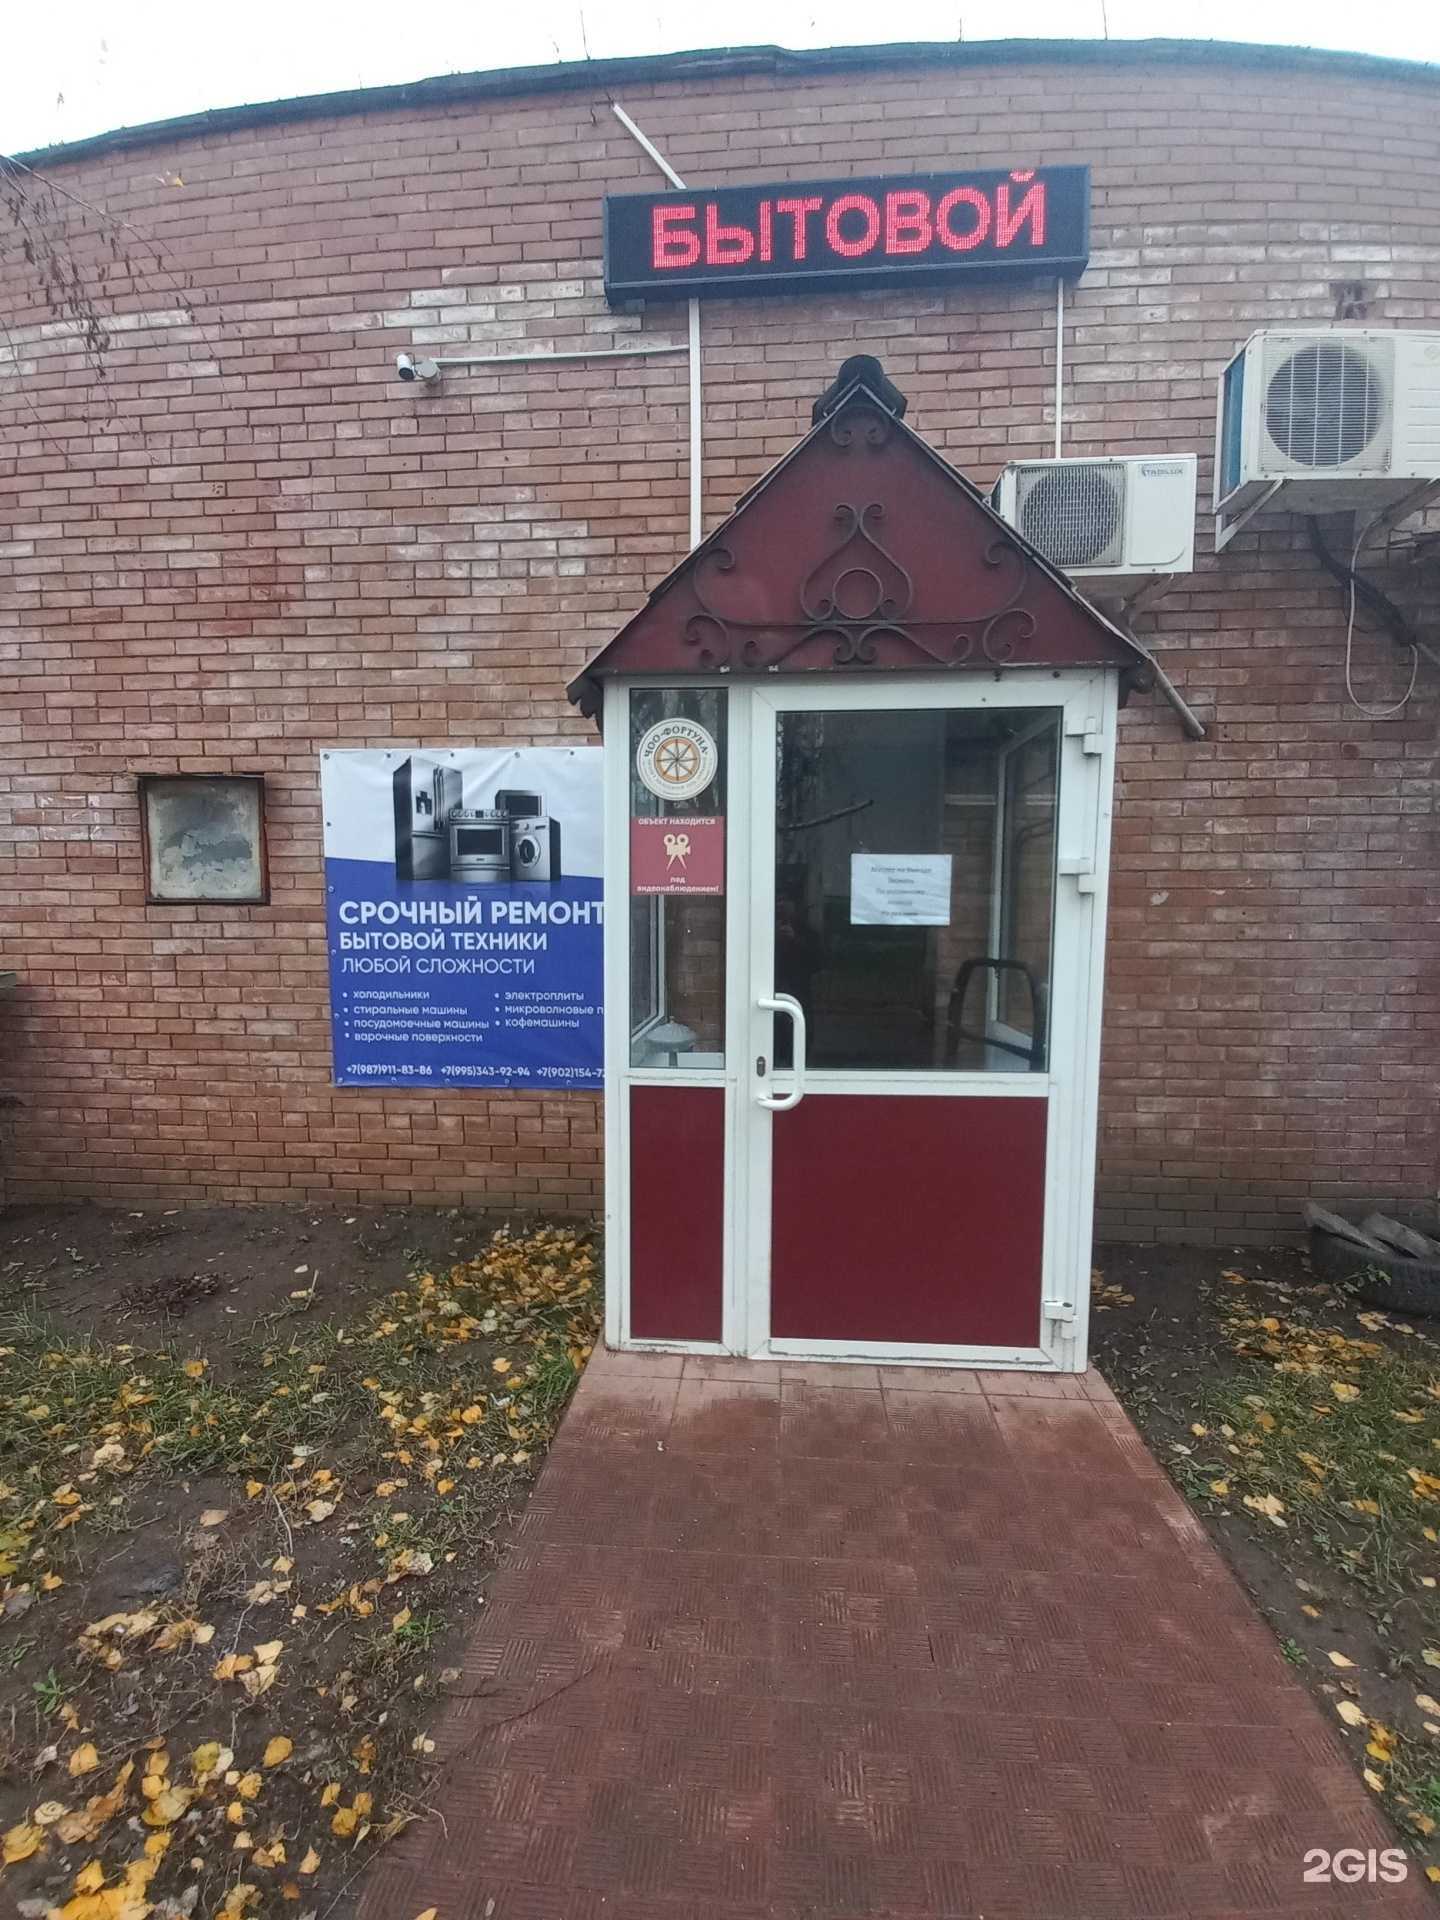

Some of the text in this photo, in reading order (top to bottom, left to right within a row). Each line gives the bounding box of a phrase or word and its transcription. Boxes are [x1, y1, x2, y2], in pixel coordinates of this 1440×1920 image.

[652, 168, 1047, 271] БЫТОВОЙ
[638, 818, 716, 827] ОБЪЕКТ НАХОДИТСЯ
[670, 877, 686, 885] под
[637, 884, 719, 894] видеонаблюдением!
[339, 896, 605, 925] СРОЧНЫЙ РЕМОНТ
[339, 928, 548, 951] БЫТОВОЙ ТЕХНИКИ
[342, 955, 536, 975] ЛЮБОЙ СЛОЖНОСТИ
[353, 990, 430, 1000] холодильники
[504, 991, 585, 1002] электроплиты
[353, 1005, 468, 1016] стиральные машины
[504, 1005, 594, 1015] микроволновые
[353, 1019, 490, 1030] посудомоечные машины
[505, 1017, 580, 1029] кофемашины
[354, 1033, 483, 1044] варочные поверхности
[346, 1064, 433, 1076] +7(987)911-83-86
[441, 1065, 531, 1077] +7(995)343-92-94
